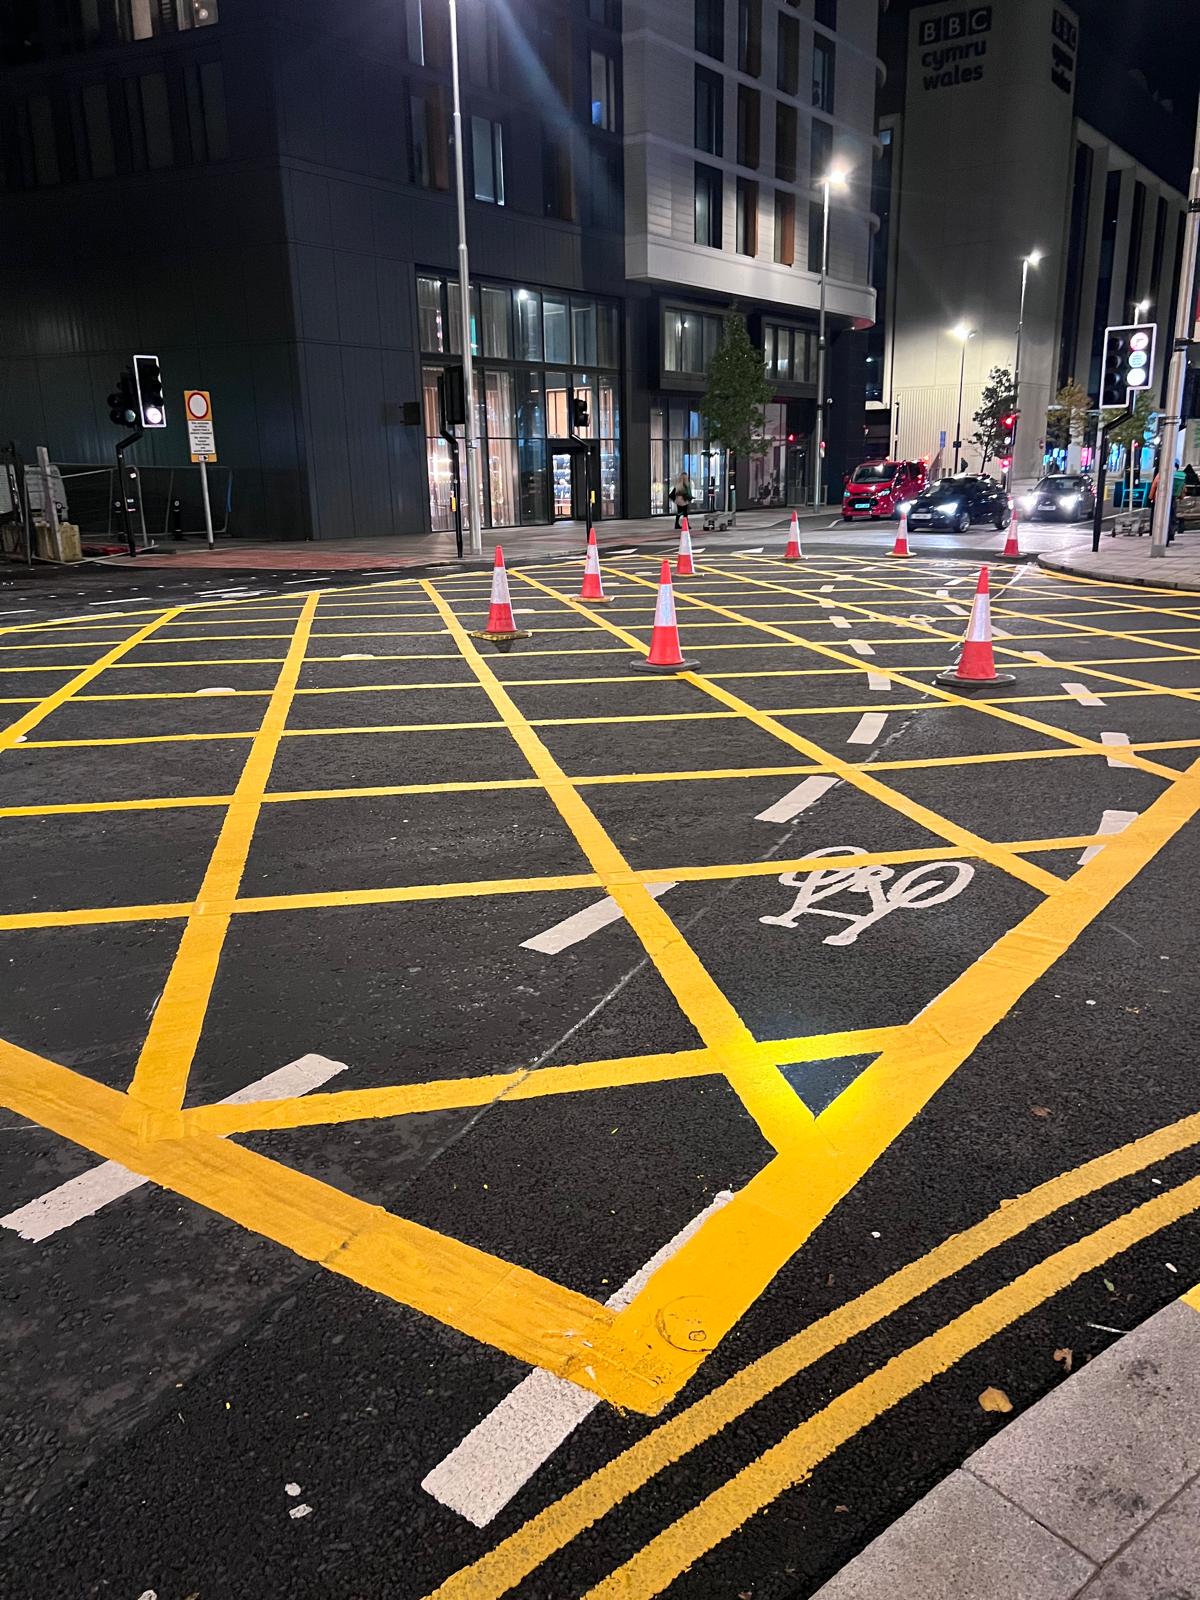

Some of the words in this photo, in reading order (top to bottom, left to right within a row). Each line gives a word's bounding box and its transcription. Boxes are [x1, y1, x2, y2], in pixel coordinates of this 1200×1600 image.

[920, 8, 990, 44] BBC
[921, 40, 986, 71] cymru
[923, 64, 984, 90] wales
